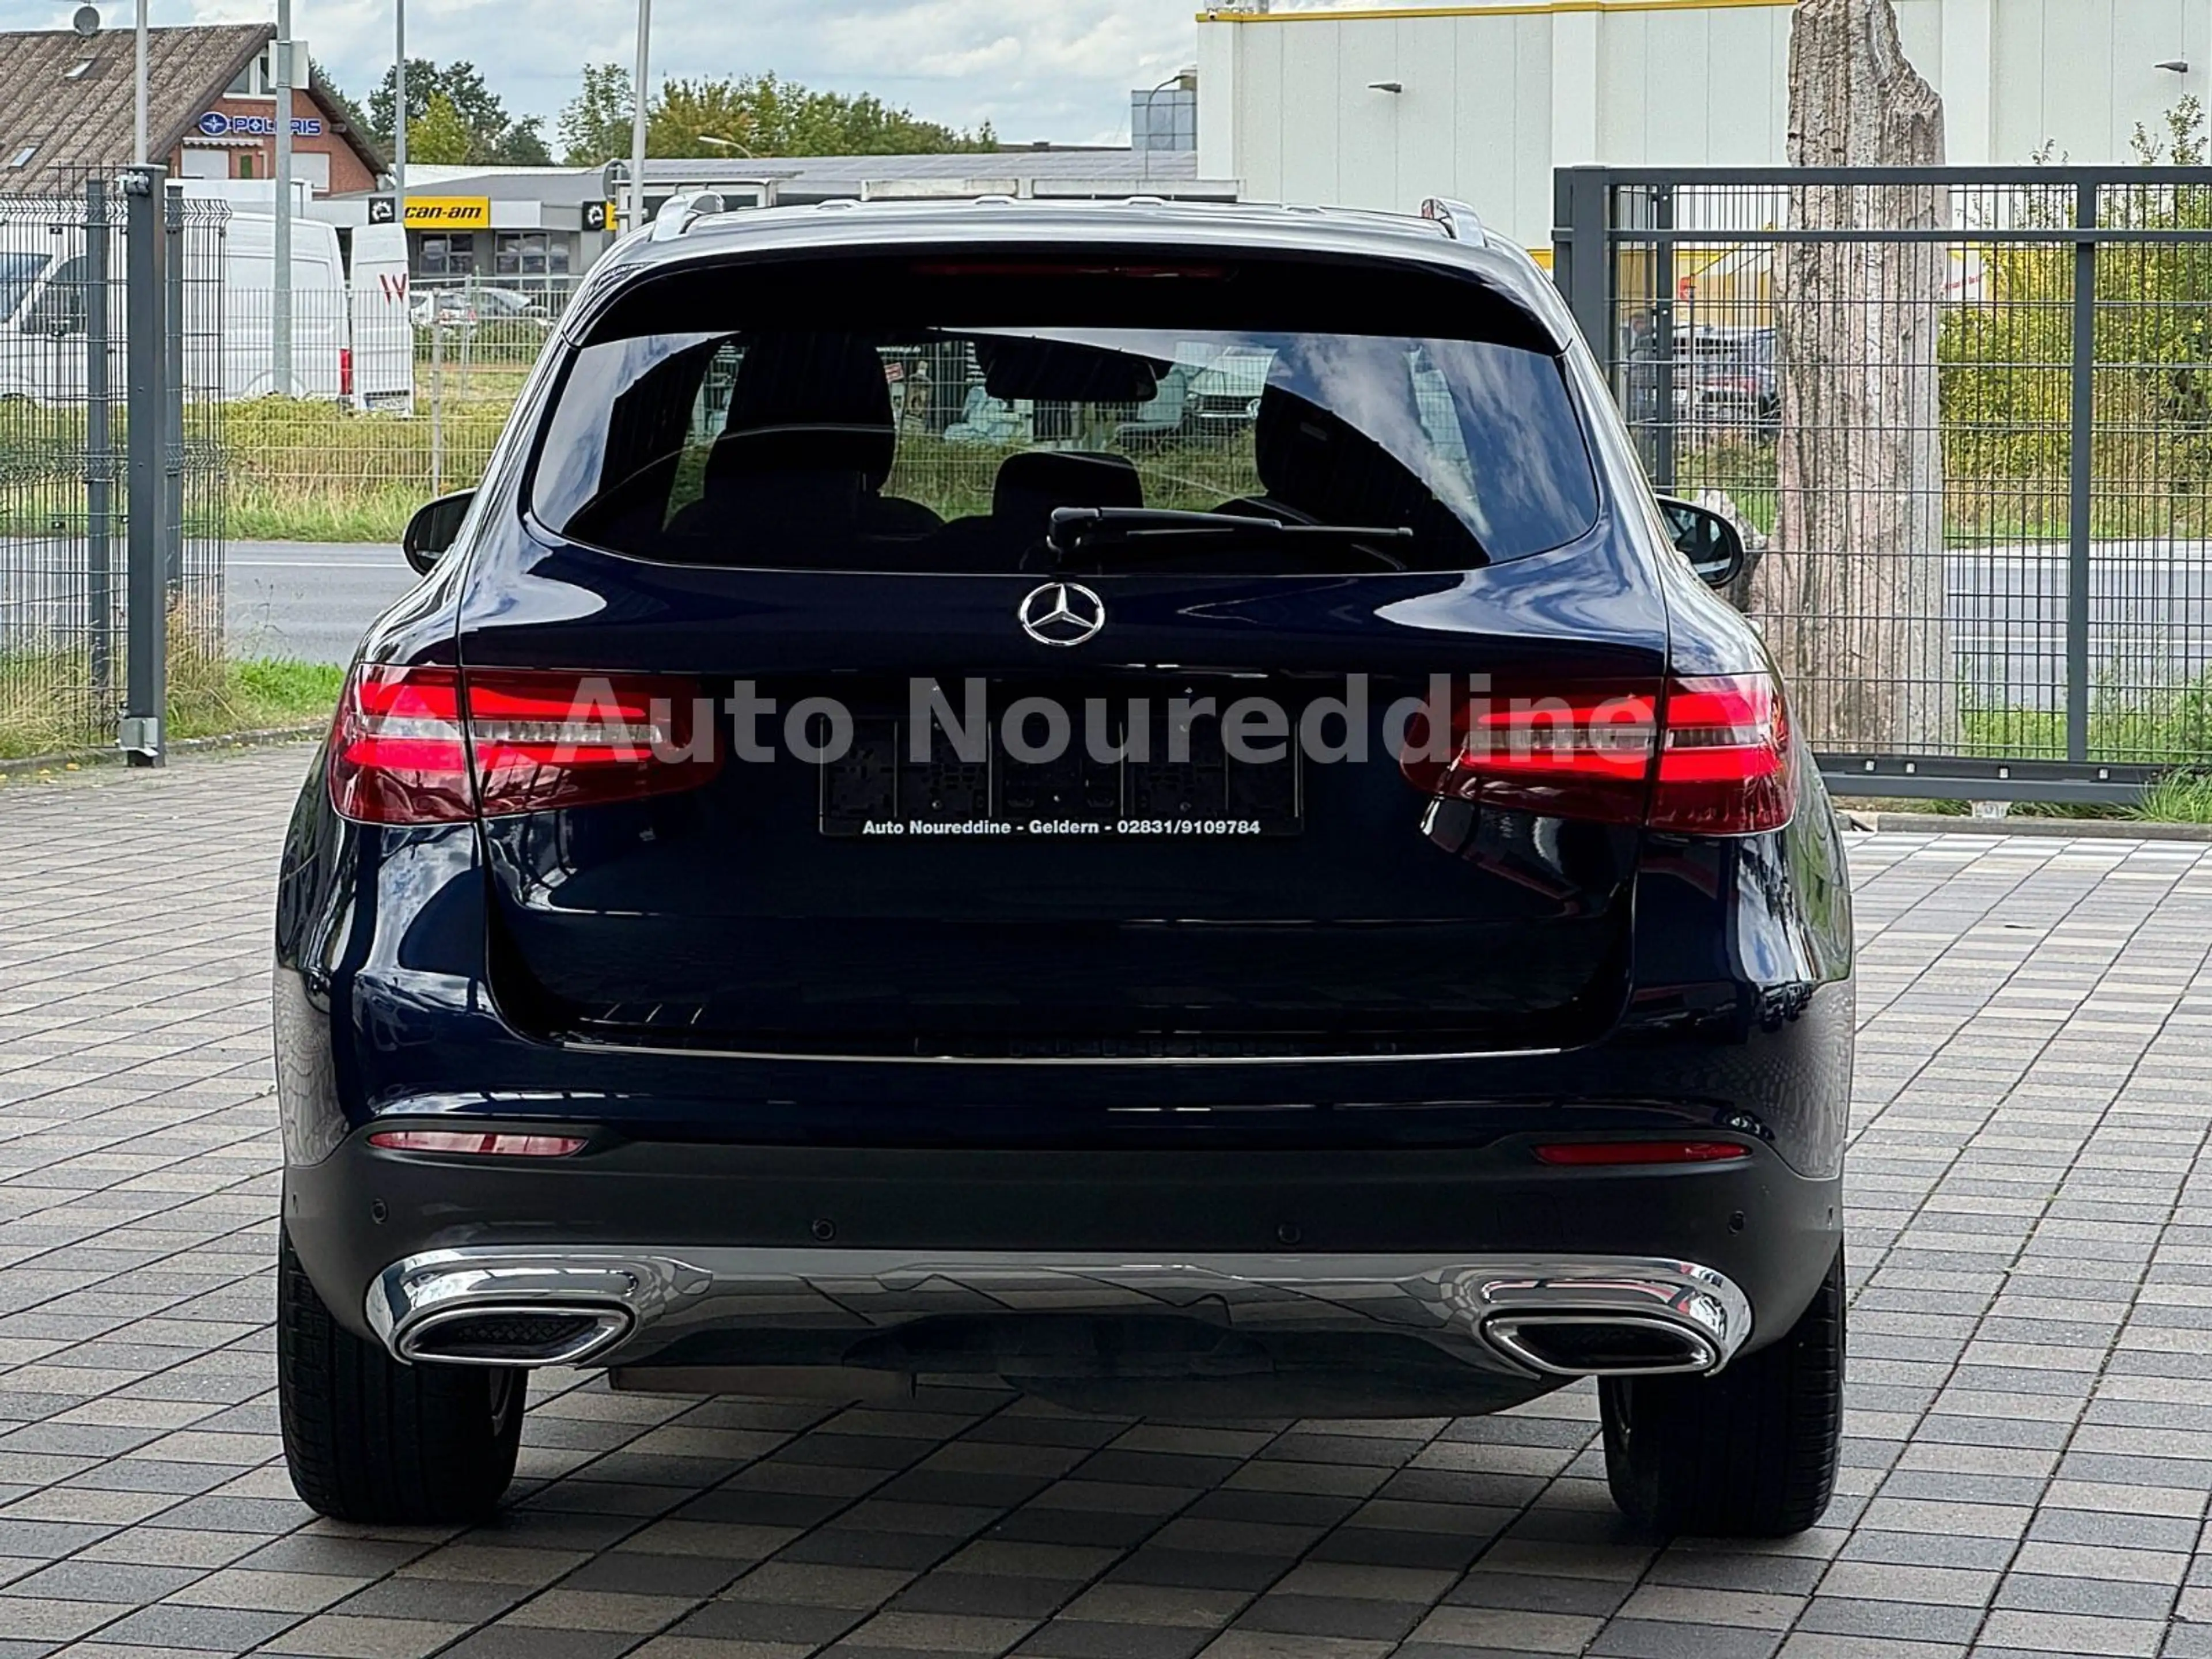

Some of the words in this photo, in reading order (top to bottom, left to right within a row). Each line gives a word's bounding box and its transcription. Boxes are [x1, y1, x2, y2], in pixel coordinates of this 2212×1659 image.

[233, 117, 321, 135] POLRIS
[404, 206, 482, 219] can-am
[862, 820, 904, 834] Auto
[909, 820, 1011, 834] Noureddine
[1029, 820, 1099, 834] Geldern
[1117, 820, 1260, 834] 02831/9109784
